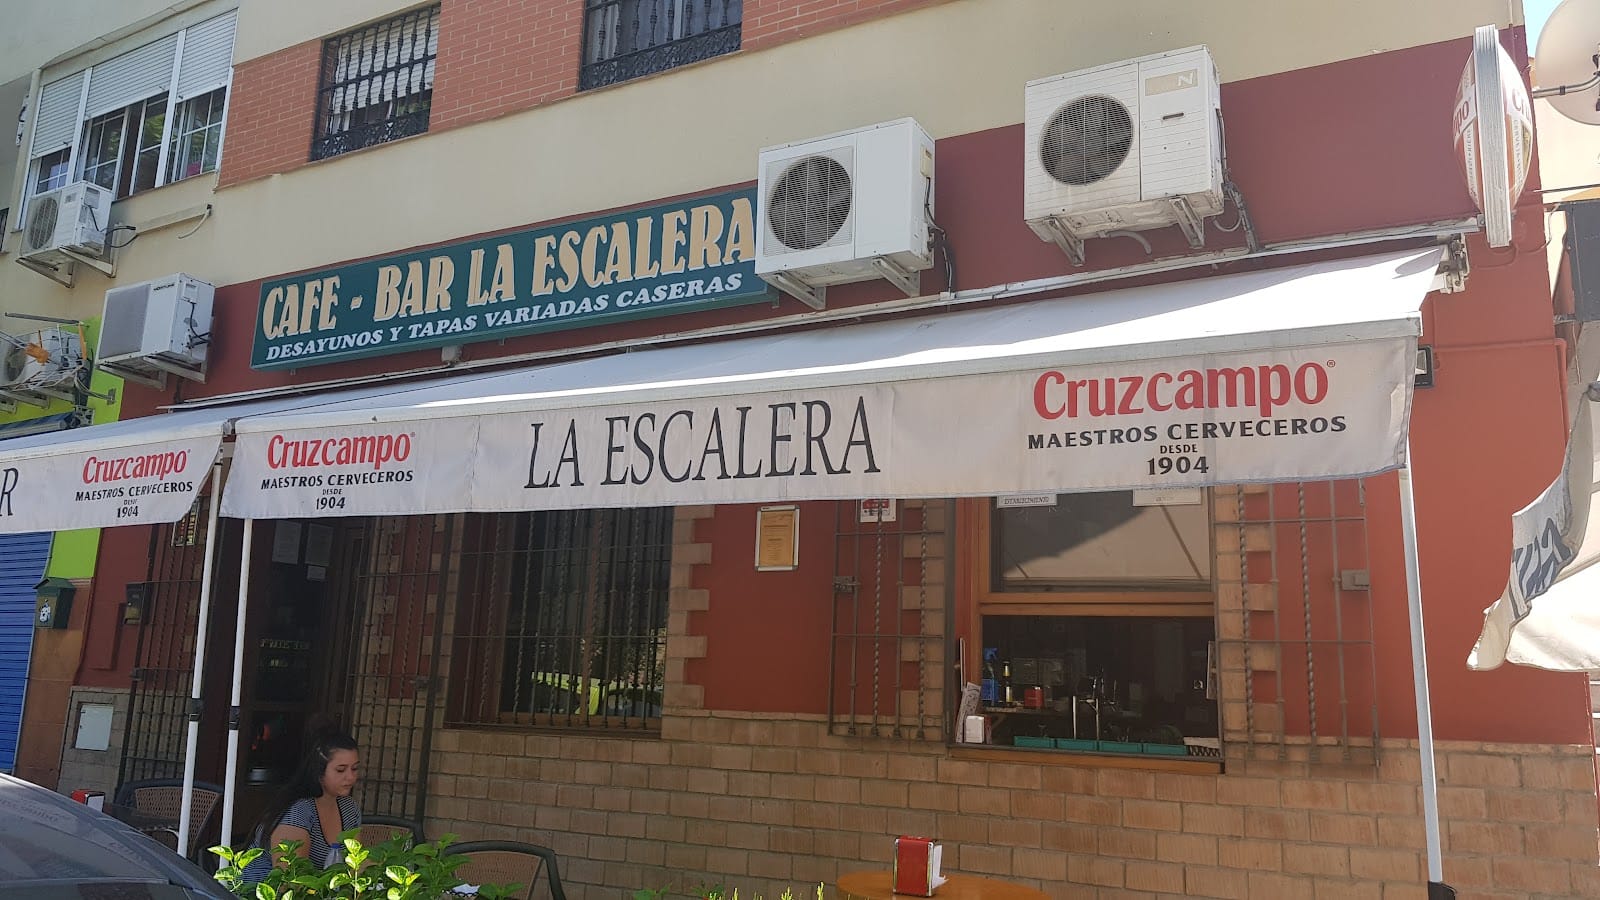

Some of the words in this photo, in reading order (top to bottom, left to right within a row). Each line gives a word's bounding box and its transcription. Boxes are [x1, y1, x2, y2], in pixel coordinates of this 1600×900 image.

[262, 275, 341, 341] CAFE
[373, 255, 455, 322] BAR
[466, 243, 516, 307] LA
[531, 197, 756, 297] ESCALERA
[265, 329, 384, 361] DESAYUNOS
[389, 326, 404, 342] Y
[408, 315, 478, 339] TAPAS
[484, 294, 610, 328] VARIADAS
[616, 272, 743, 307] CASERAS
[524, 418, 585, 489] LA
[600, 395, 881, 486] ESCALERA
[1027, 425, 1158, 449] MAESTROS
[1167, 415, 1347, 441] CERVECEROS
[1159, 444, 1198, 454] DESDE
[1147, 456, 1209, 476] 1904
[261, 475, 323, 490] MAESTROS
[327, 470, 414, 486] CERVECEROS
[75, 487, 125, 502] MAESTROS
[128, 481, 193, 497] CERVECEROS
[116, 505, 139, 518] 1904
[316, 497, 346, 510] 1904
